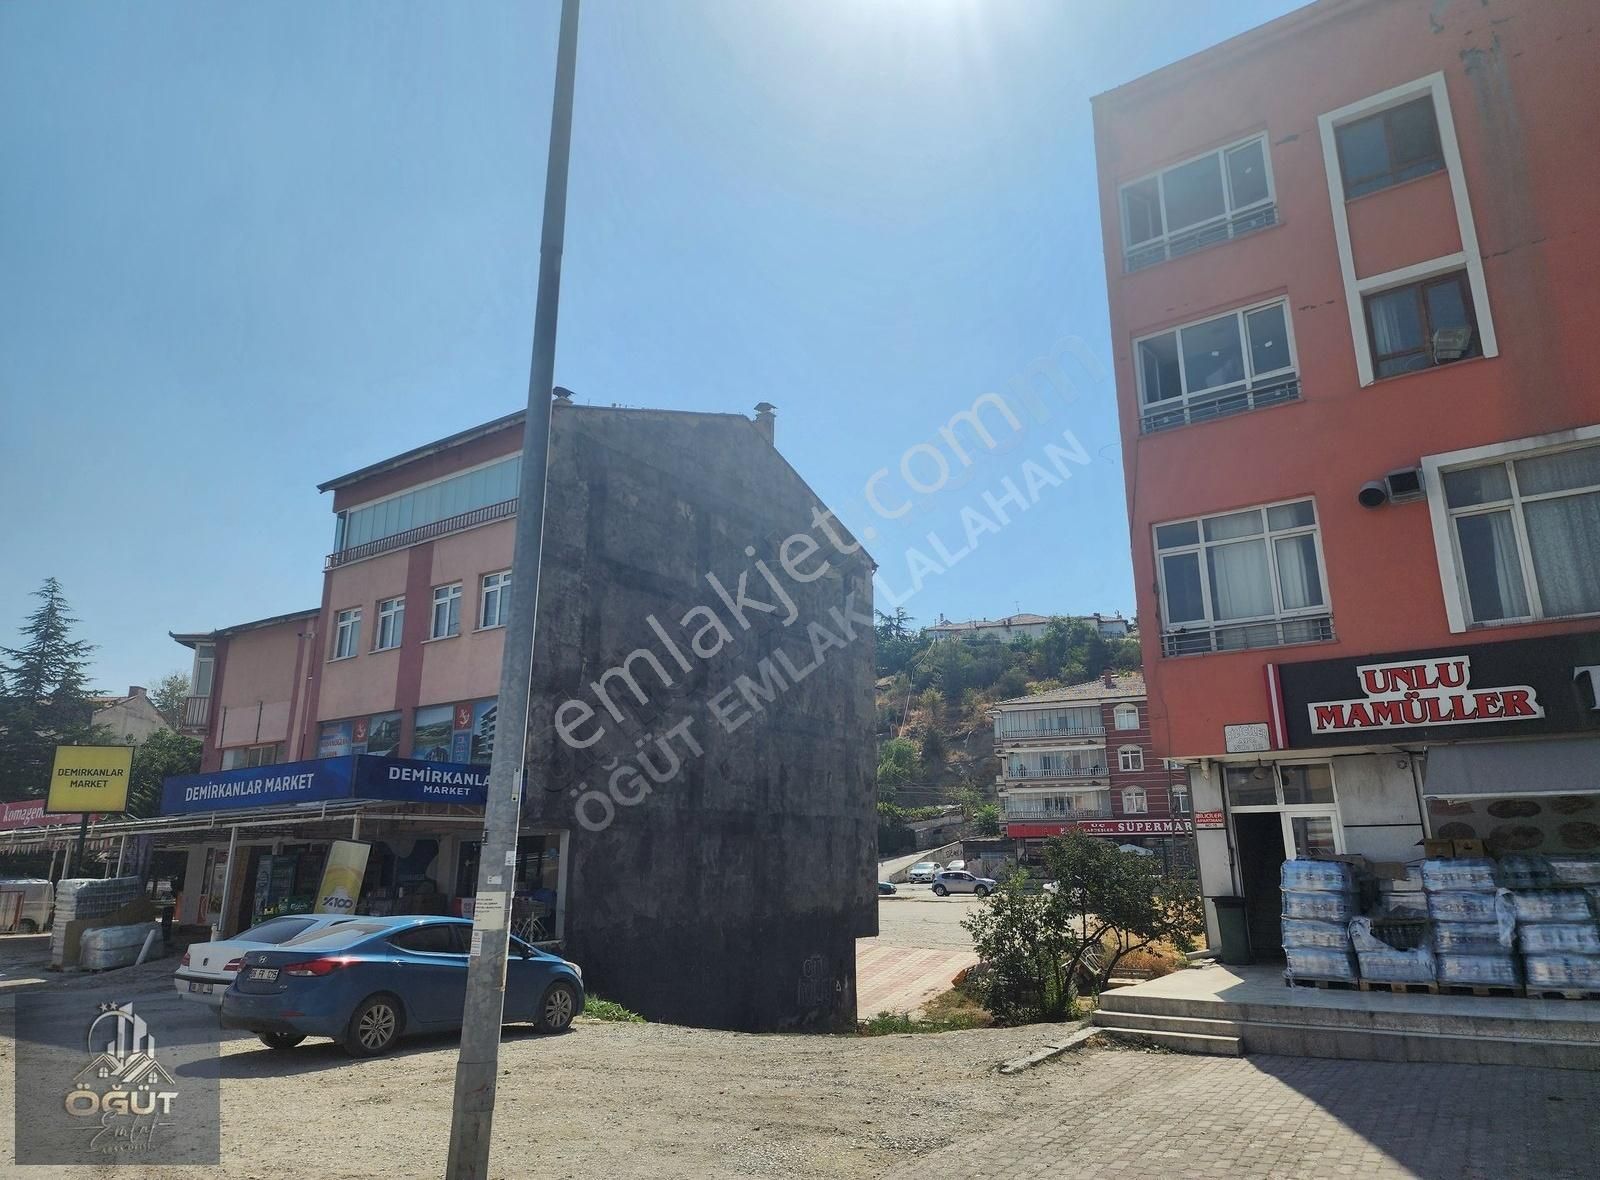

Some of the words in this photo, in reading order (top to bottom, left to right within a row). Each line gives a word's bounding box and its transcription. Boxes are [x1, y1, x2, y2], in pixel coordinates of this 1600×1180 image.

[1362, 661, 1465, 694] UNLU
[1314, 690, 1537, 730] MAMÜLLER
[70, 779, 109, 788] MARKET
[388, 766, 491, 786] DEMİRKANLA
[185, 779, 262, 801] DEMİRKANLAR
[264, 773, 314, 793] MARKET
[423, 785, 471, 796] MARKET
[3, 805, 46, 826] komagen
[1117, 820, 1193, 833] SÜPERMAR
